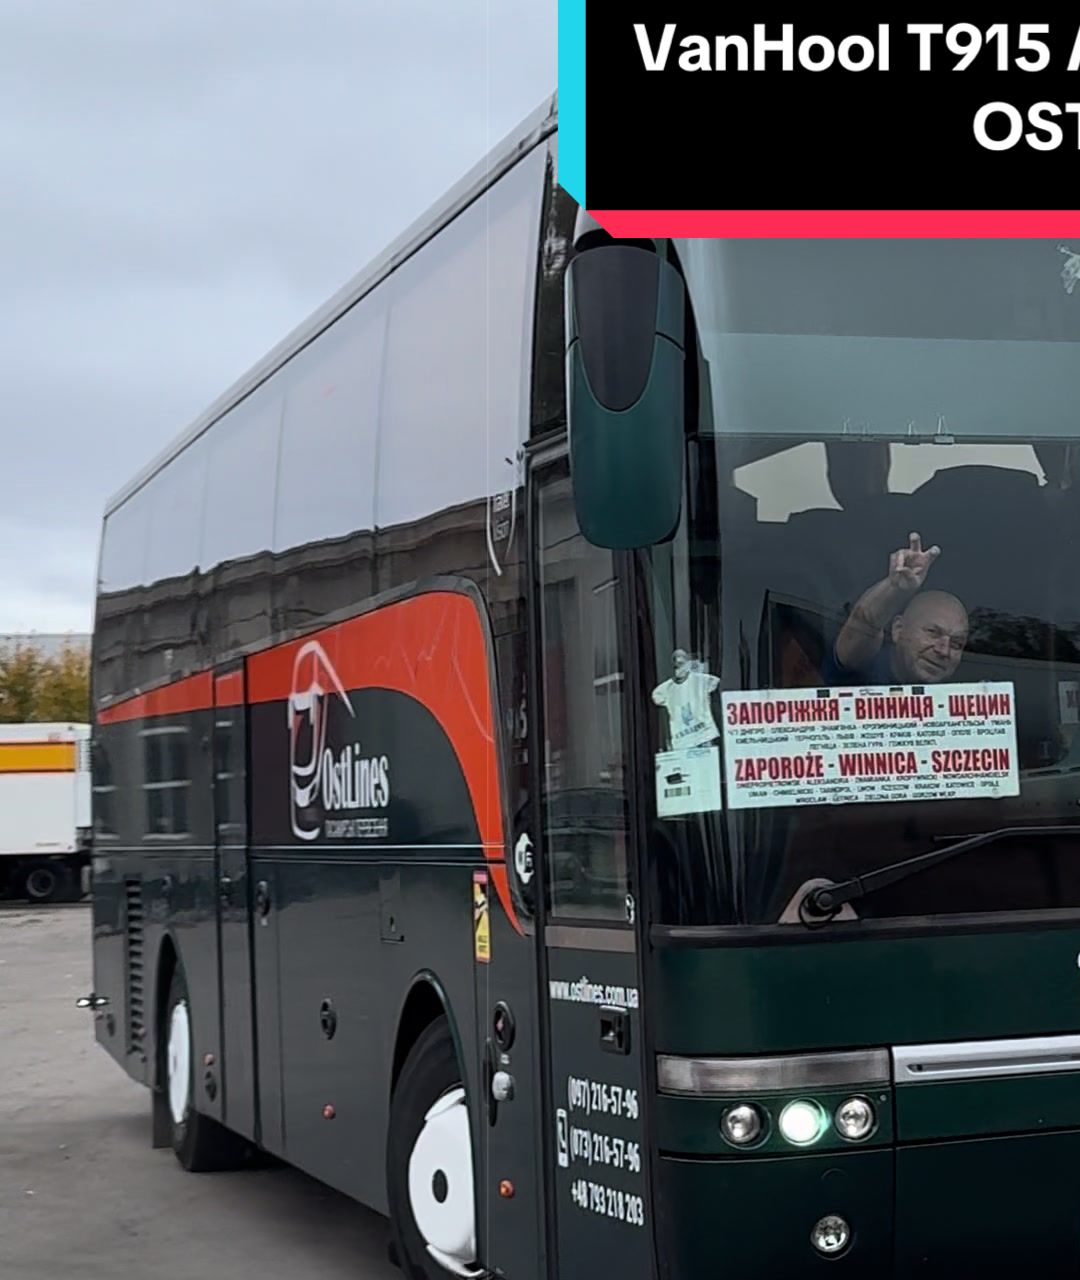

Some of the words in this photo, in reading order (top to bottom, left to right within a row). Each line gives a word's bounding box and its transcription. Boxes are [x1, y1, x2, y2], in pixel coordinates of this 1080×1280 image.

[727, 698, 840, 725] ЗАПОРІЖЖЯ
[855, 696, 934, 721] ВІННИЦЯ
[948, 694, 1011, 720] ЩЕЦИН
[322, 742, 390, 812] OstLines
[735, 751, 824, 781] ZAPOROŻE
[838, 752, 918, 777] WINNICA
[931, 748, 1010, 773] SZCZECIN
[549, 979, 639, 1008] www.ostlines.com.ua
[568, 1076, 590, 1115] (097)
[592, 1082, 639, 1119] 216-57-96
[570, 1125, 592, 1166] (073)
[593, 1133, 640, 1173] 216-57-96
[572, 1179, 588, 1209] +48
[589, 1182, 605, 1214] 793
[625, 1193, 644, 1226] 203
